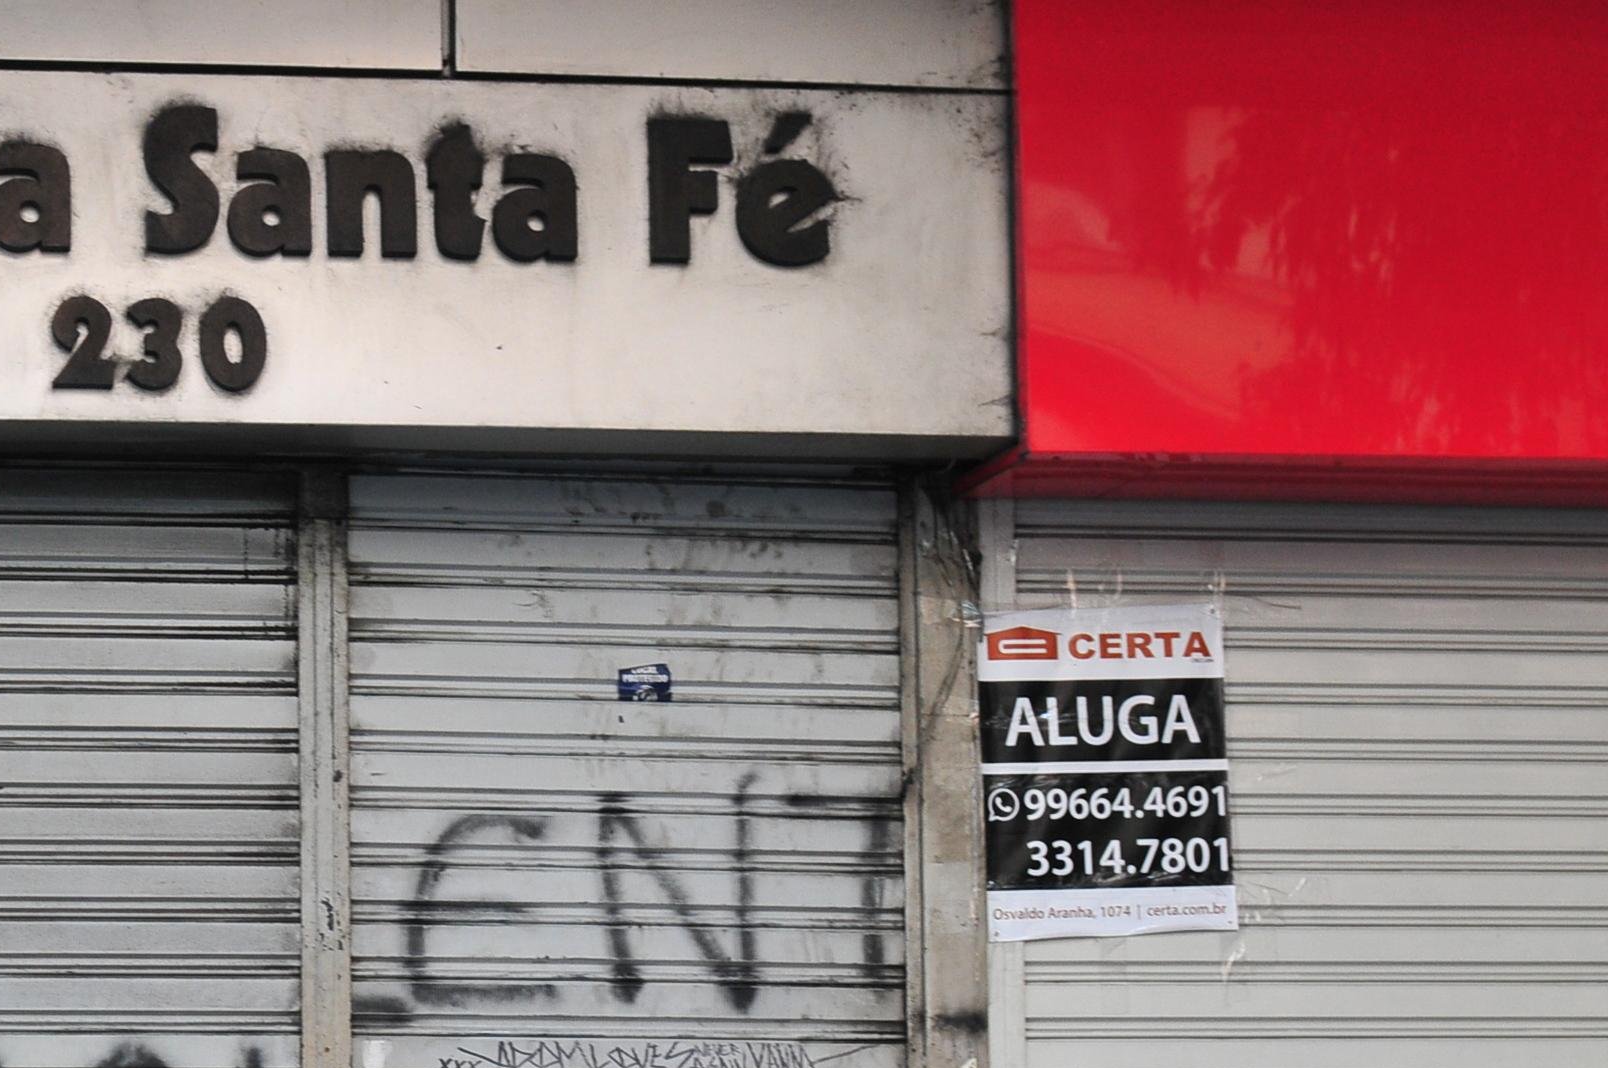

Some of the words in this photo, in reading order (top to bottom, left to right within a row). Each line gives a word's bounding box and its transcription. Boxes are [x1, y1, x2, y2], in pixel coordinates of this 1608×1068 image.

[142, 103, 579, 264] Santa
[647, 110, 842, 268] Fé
[50, 294, 269, 393] 230
[1068, 631, 1212, 660] CERTA
[1005, 694, 1202, 747] ALUGA
[1023, 785, 1227, 821] 99664.4691
[1026, 837, 1230, 877] 3314.7801
[993, 907, 1045, 921] Osvaldo
[1047, 906, 1097, 921] Aranha,
[1100, 905, 1131, 918] 1074
[1147, 903, 1227, 917] certa.com.br
